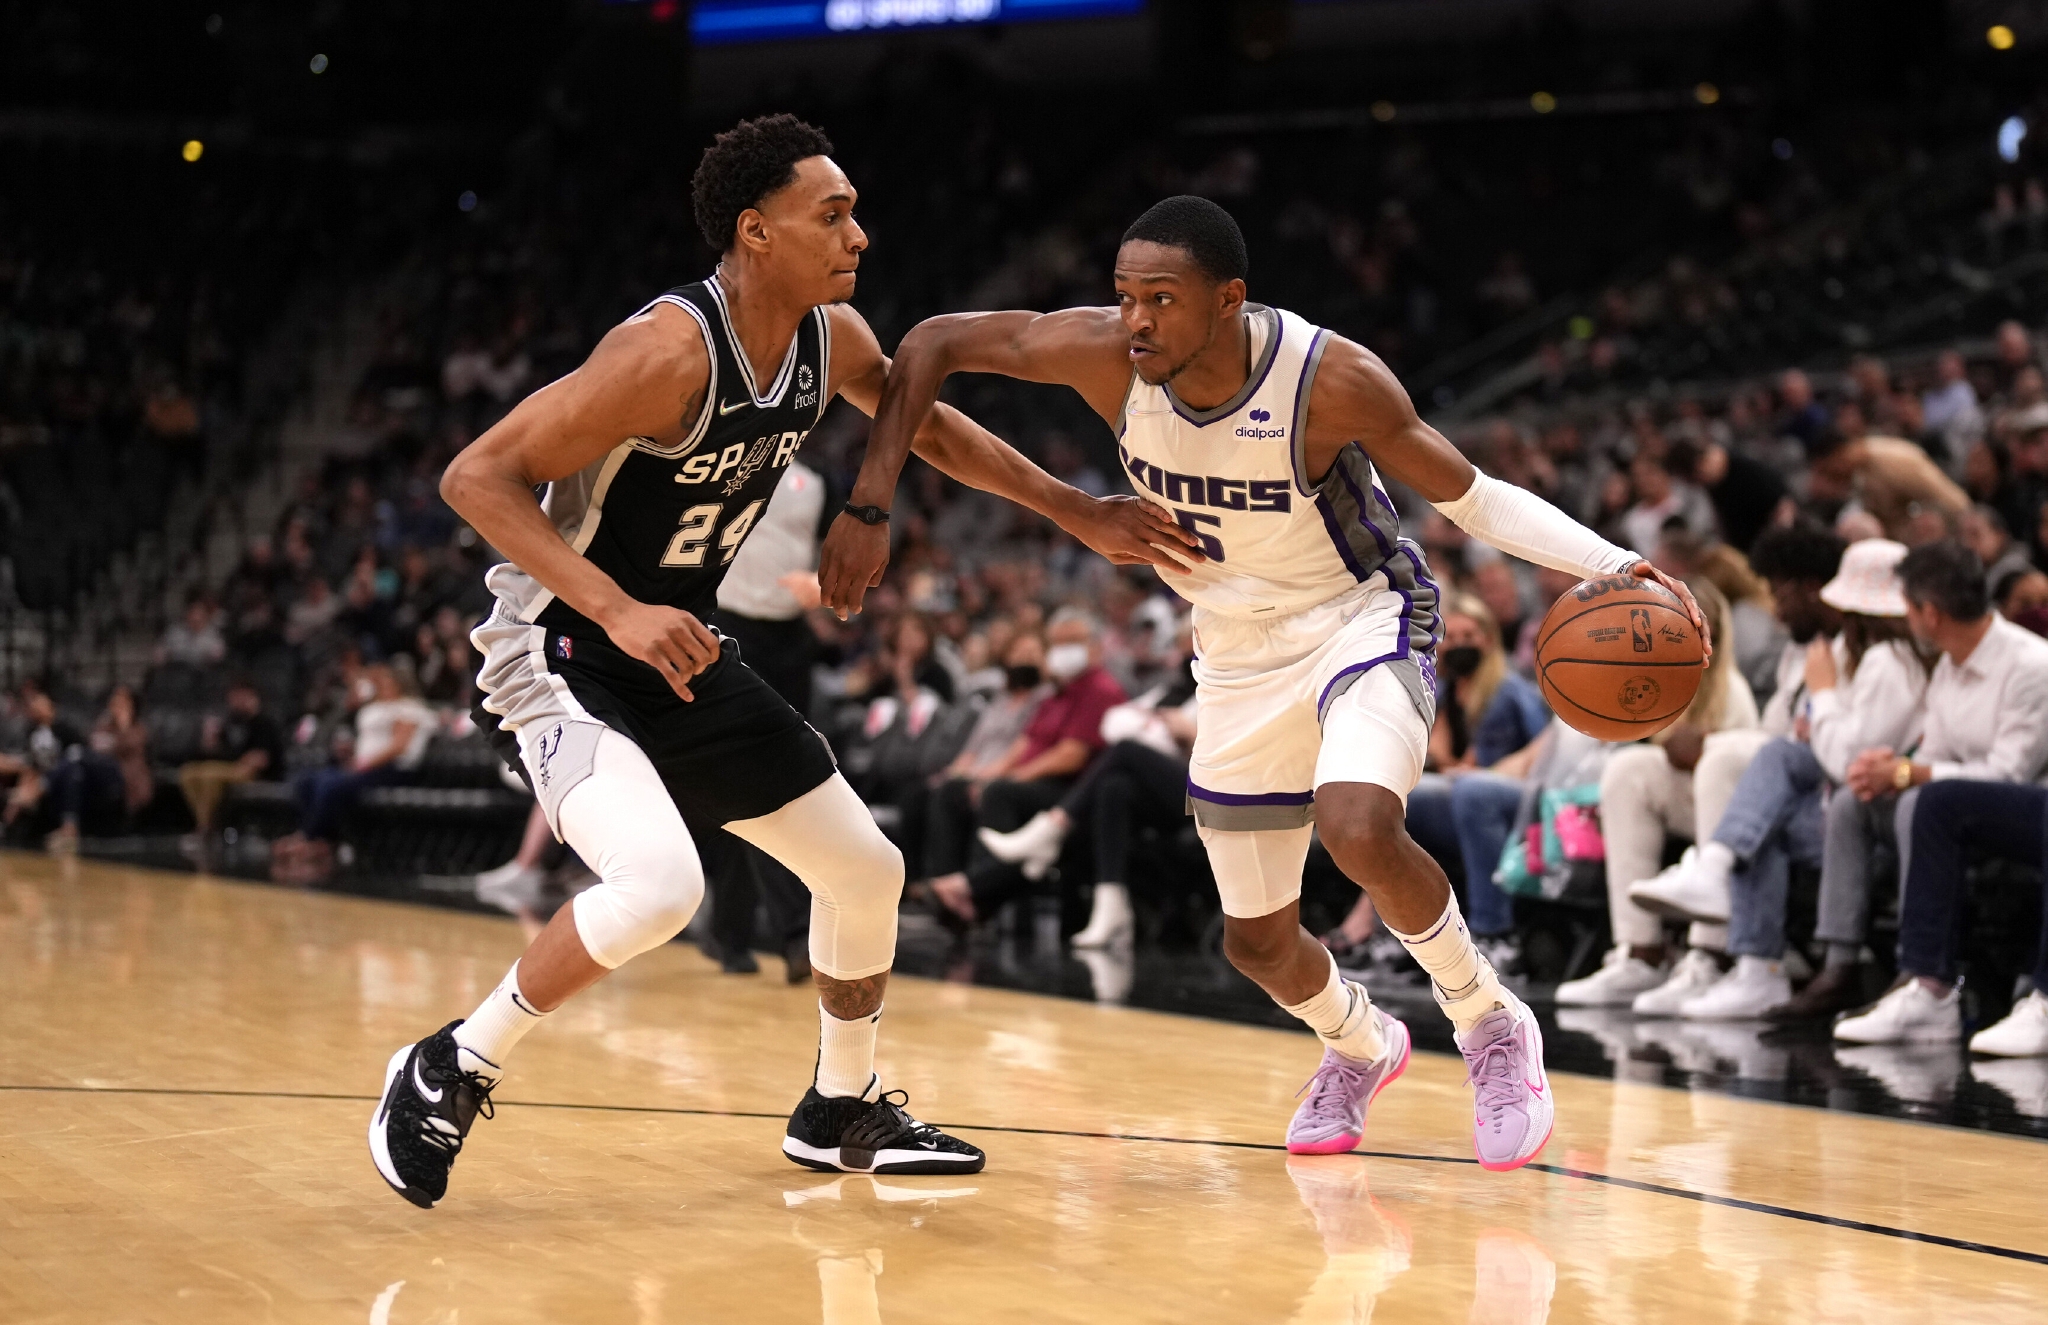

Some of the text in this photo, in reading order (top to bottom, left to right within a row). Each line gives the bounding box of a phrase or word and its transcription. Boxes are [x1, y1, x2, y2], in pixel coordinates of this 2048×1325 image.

[794, 390, 817, 409] frost
[1235, 426, 1285, 441] dialpad
[659, 498, 767, 567] 24
[1172, 507, 1225, 563] 5
